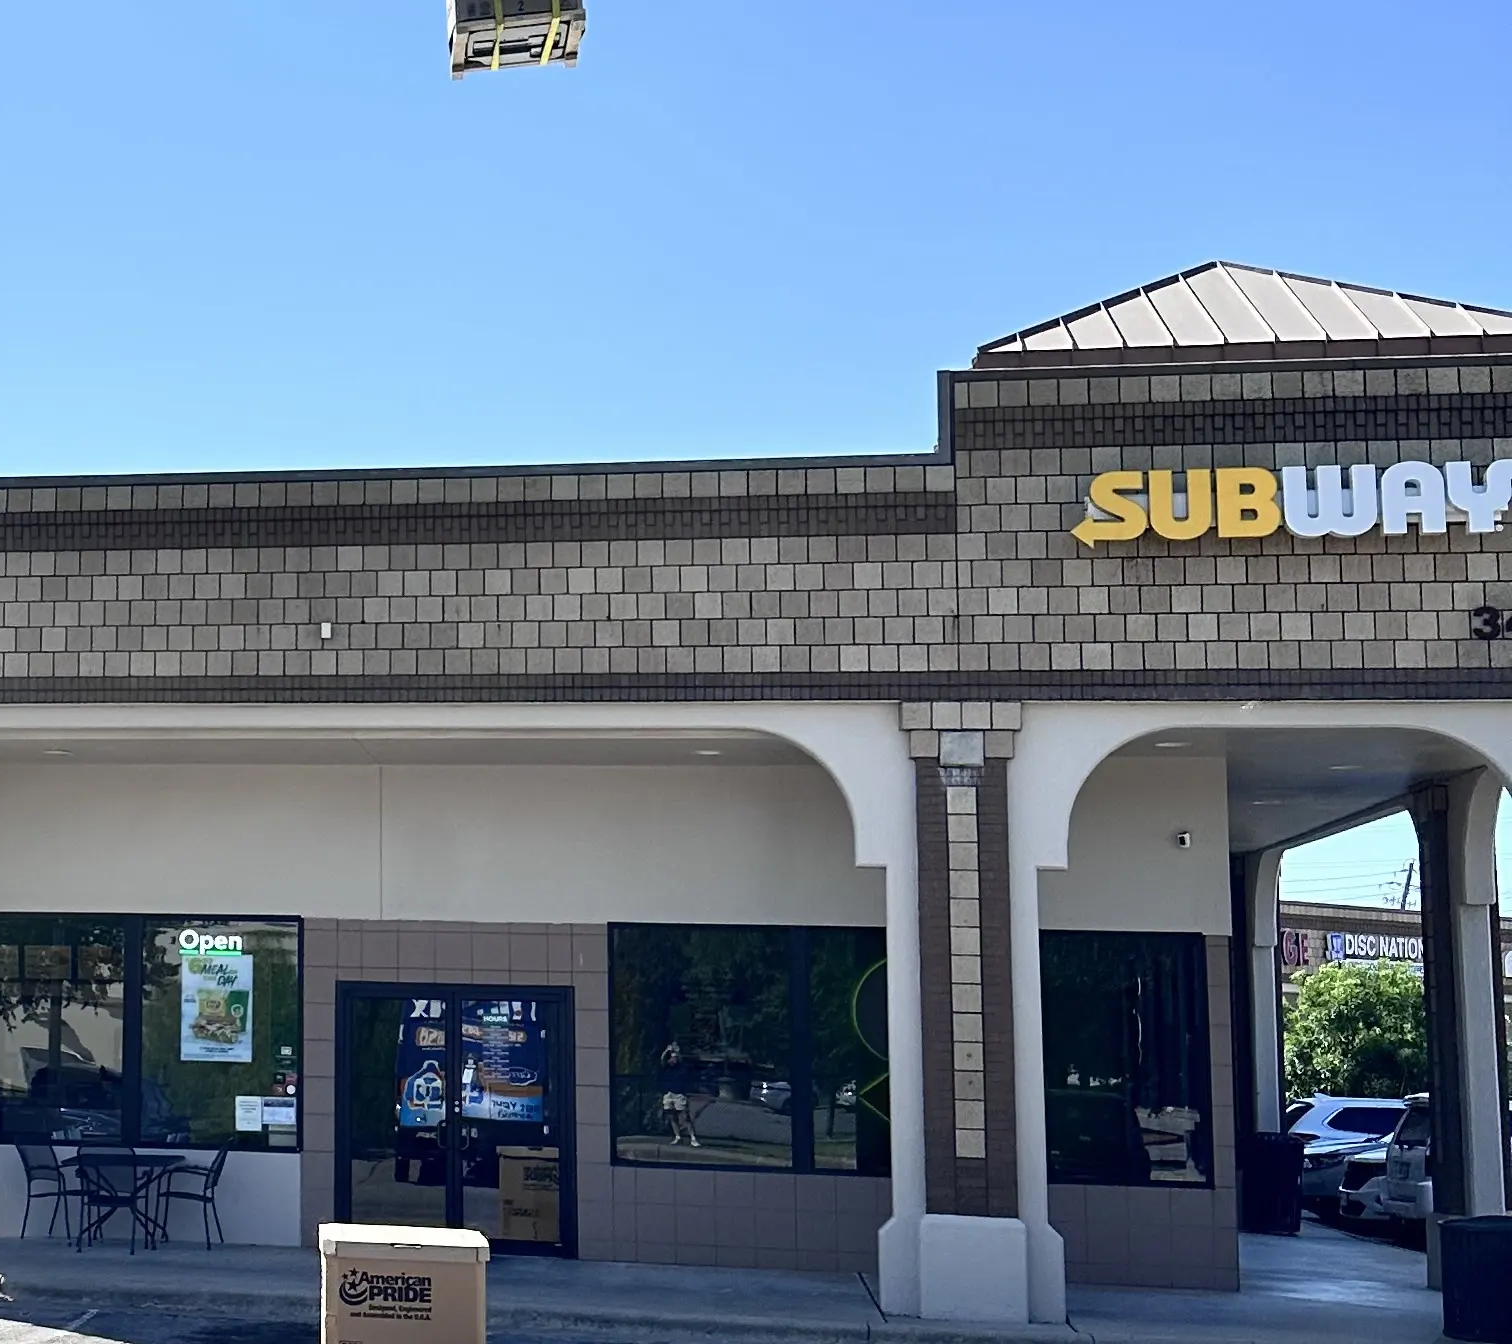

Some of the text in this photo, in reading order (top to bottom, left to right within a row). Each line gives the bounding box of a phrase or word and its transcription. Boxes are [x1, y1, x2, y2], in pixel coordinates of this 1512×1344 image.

[517, 0, 525, 12] 2
[1071, 459, 1512, 549] SUBWAY
[179, 929, 243, 955] Open
[1345, 934, 1377, 957] DISC
[359, 1271, 432, 1287] American
[369, 1285, 432, 1303] PRIDE
